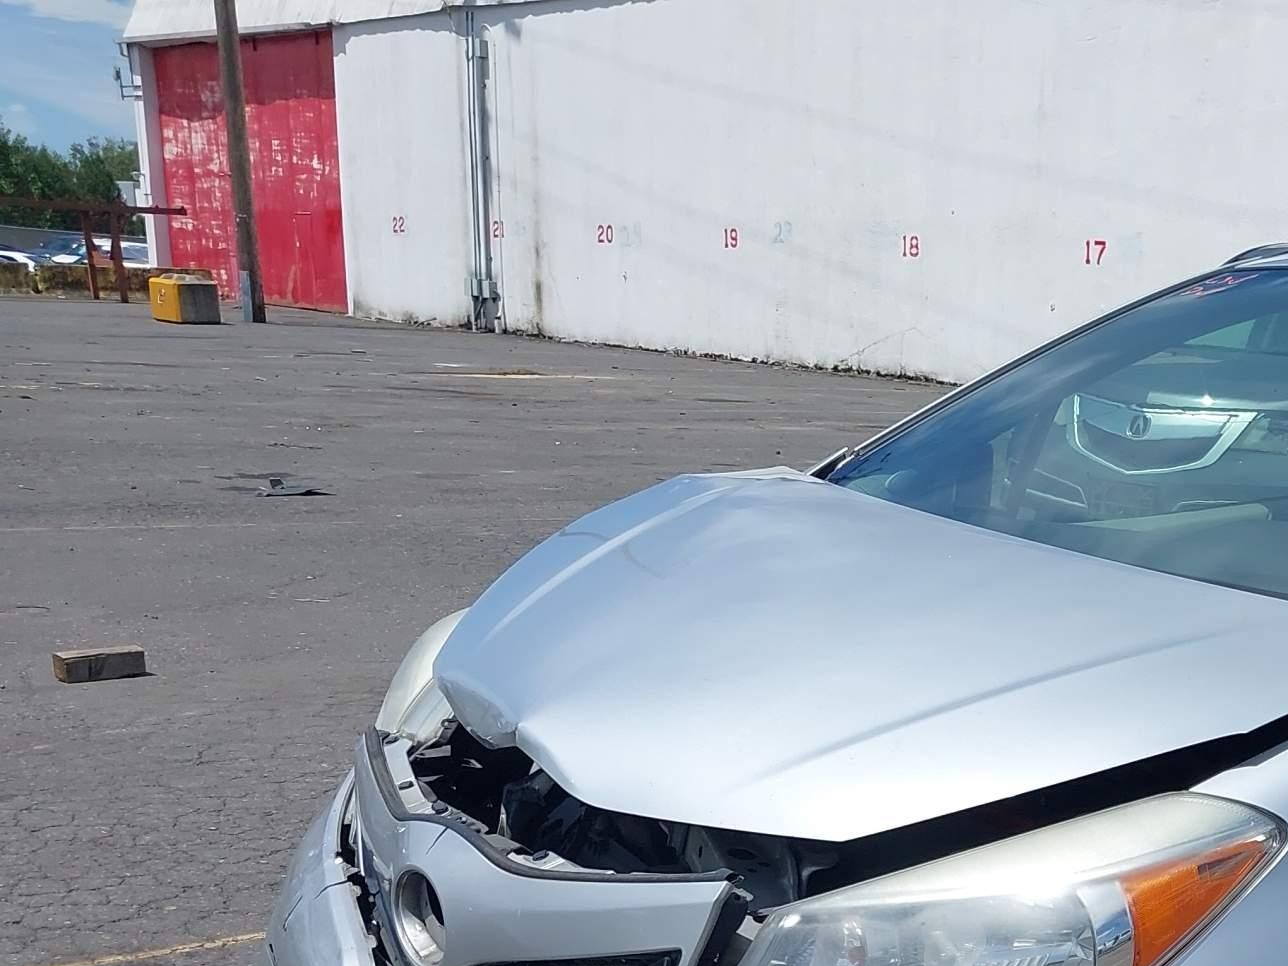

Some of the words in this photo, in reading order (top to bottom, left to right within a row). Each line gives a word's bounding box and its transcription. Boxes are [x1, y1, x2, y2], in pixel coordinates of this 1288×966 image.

[392, 216, 406, 234] 22
[492, 220, 505, 239] 21
[597, 224, 614, 244] 20
[723, 227, 738, 249] 19
[902, 235, 920, 257] 18
[1084, 239, 1108, 265] 17
